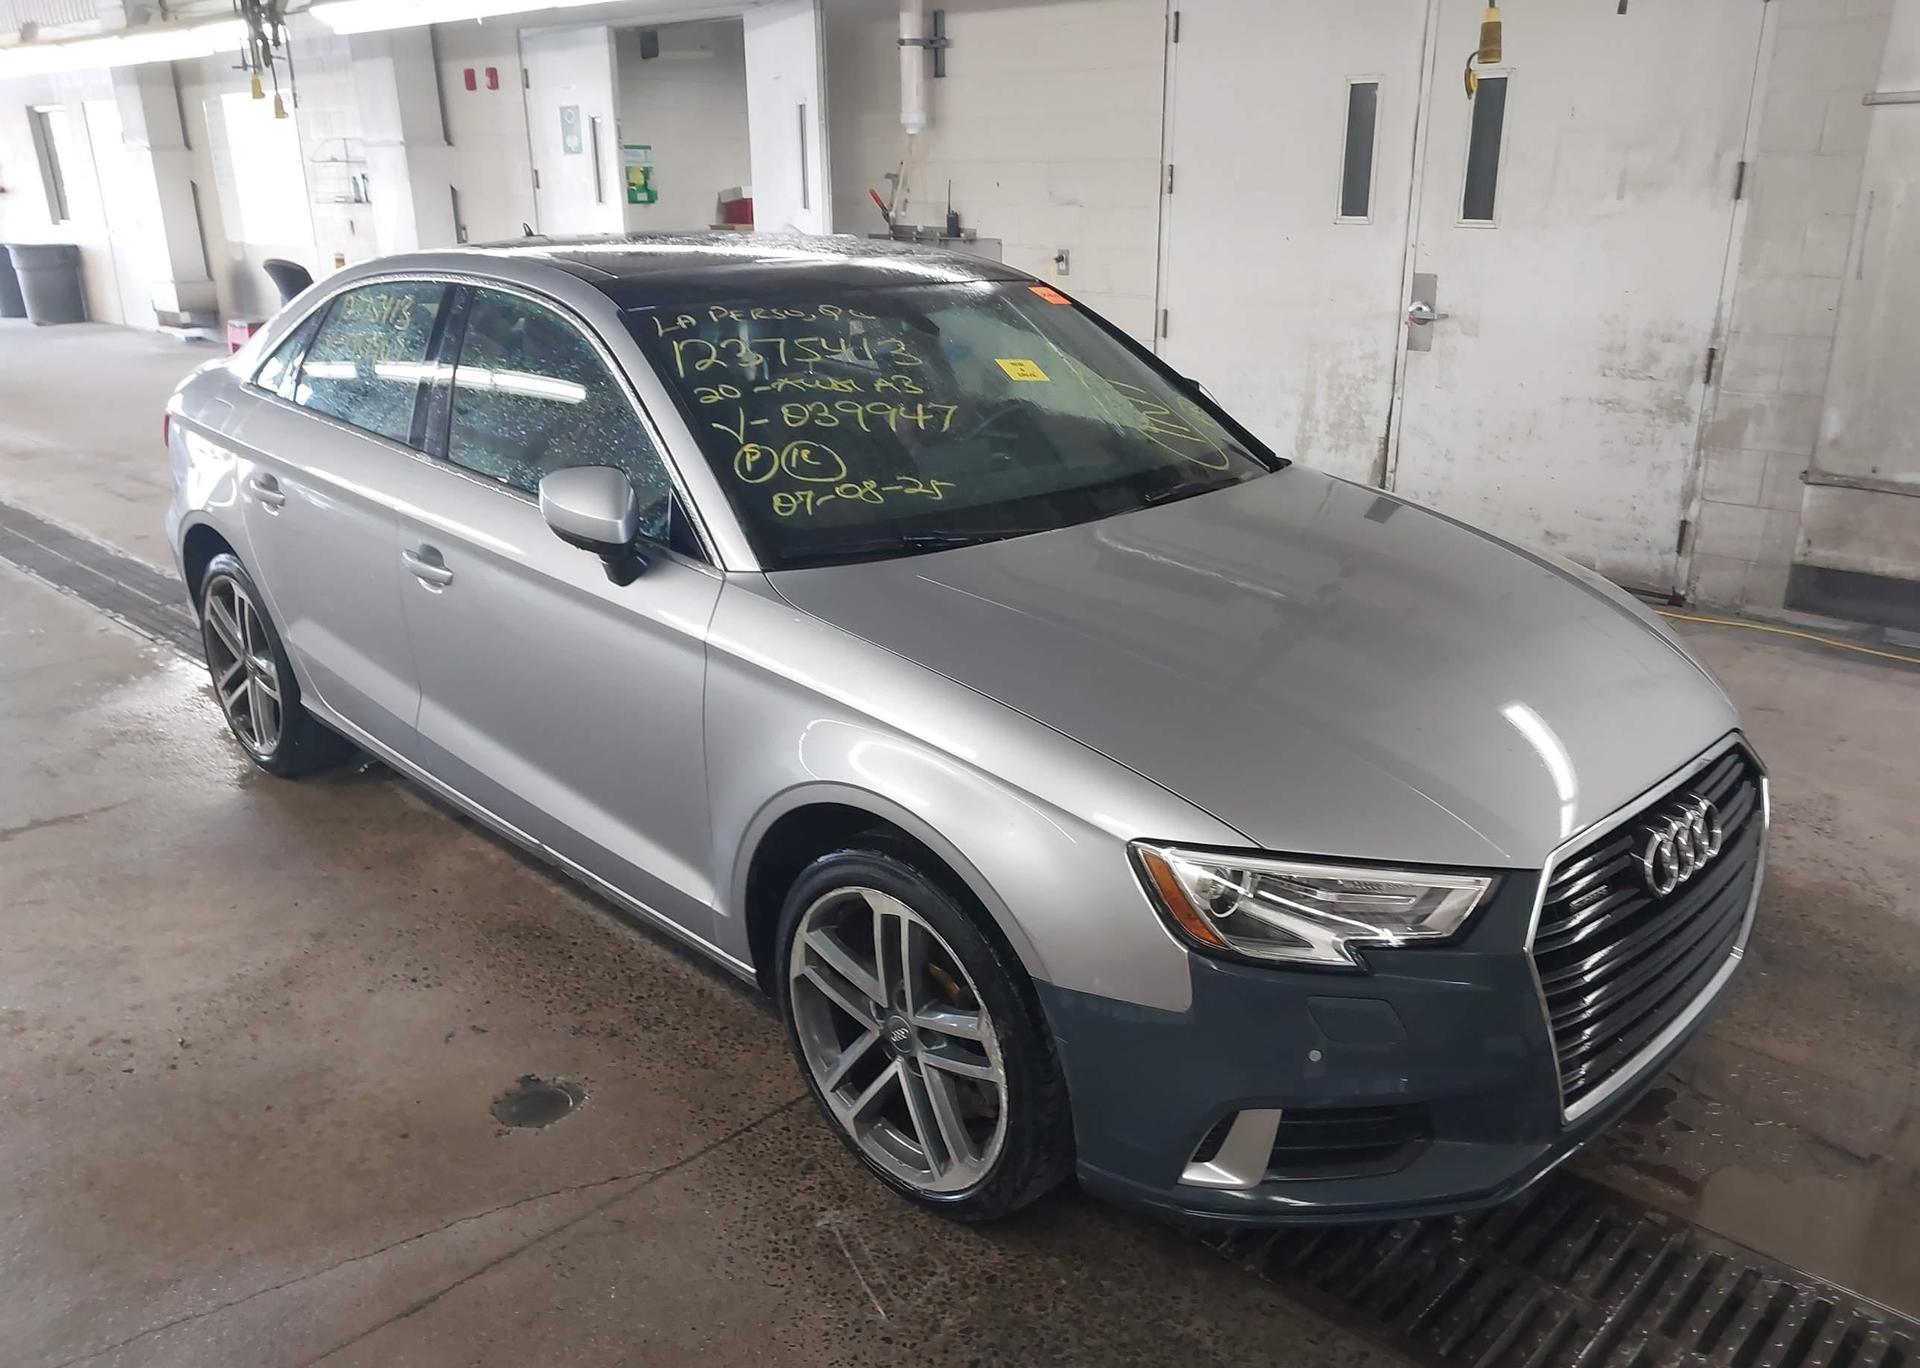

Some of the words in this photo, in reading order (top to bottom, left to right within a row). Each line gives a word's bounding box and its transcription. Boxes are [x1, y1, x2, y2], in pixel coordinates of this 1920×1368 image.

[653, 314, 697, 338] LA
[672, 337, 923, 379] 12375413
[772, 474, 956, 517] 07-08-25
